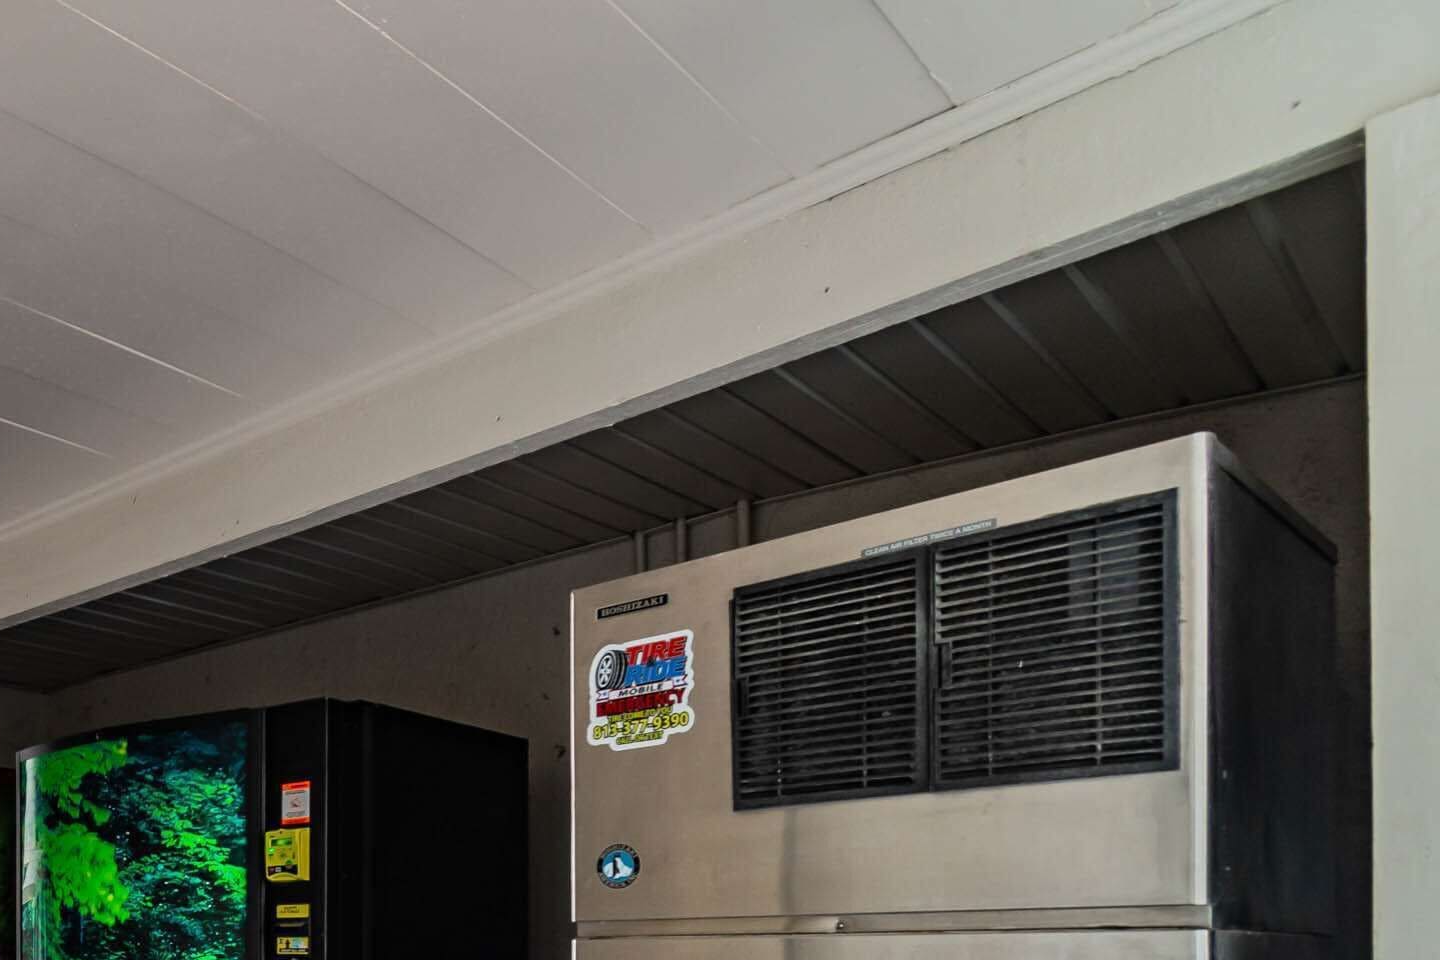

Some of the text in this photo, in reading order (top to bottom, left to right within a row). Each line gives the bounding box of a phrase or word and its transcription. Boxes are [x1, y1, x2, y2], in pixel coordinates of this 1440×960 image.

[601, 597, 664, 616] HOSHIZAKI
[625, 636, 687, 667] TIRE
[623, 656, 687, 688] RIDE
[618, 683, 664, 697] MOBILE
[593, 711, 689, 740] 813-377-9390
